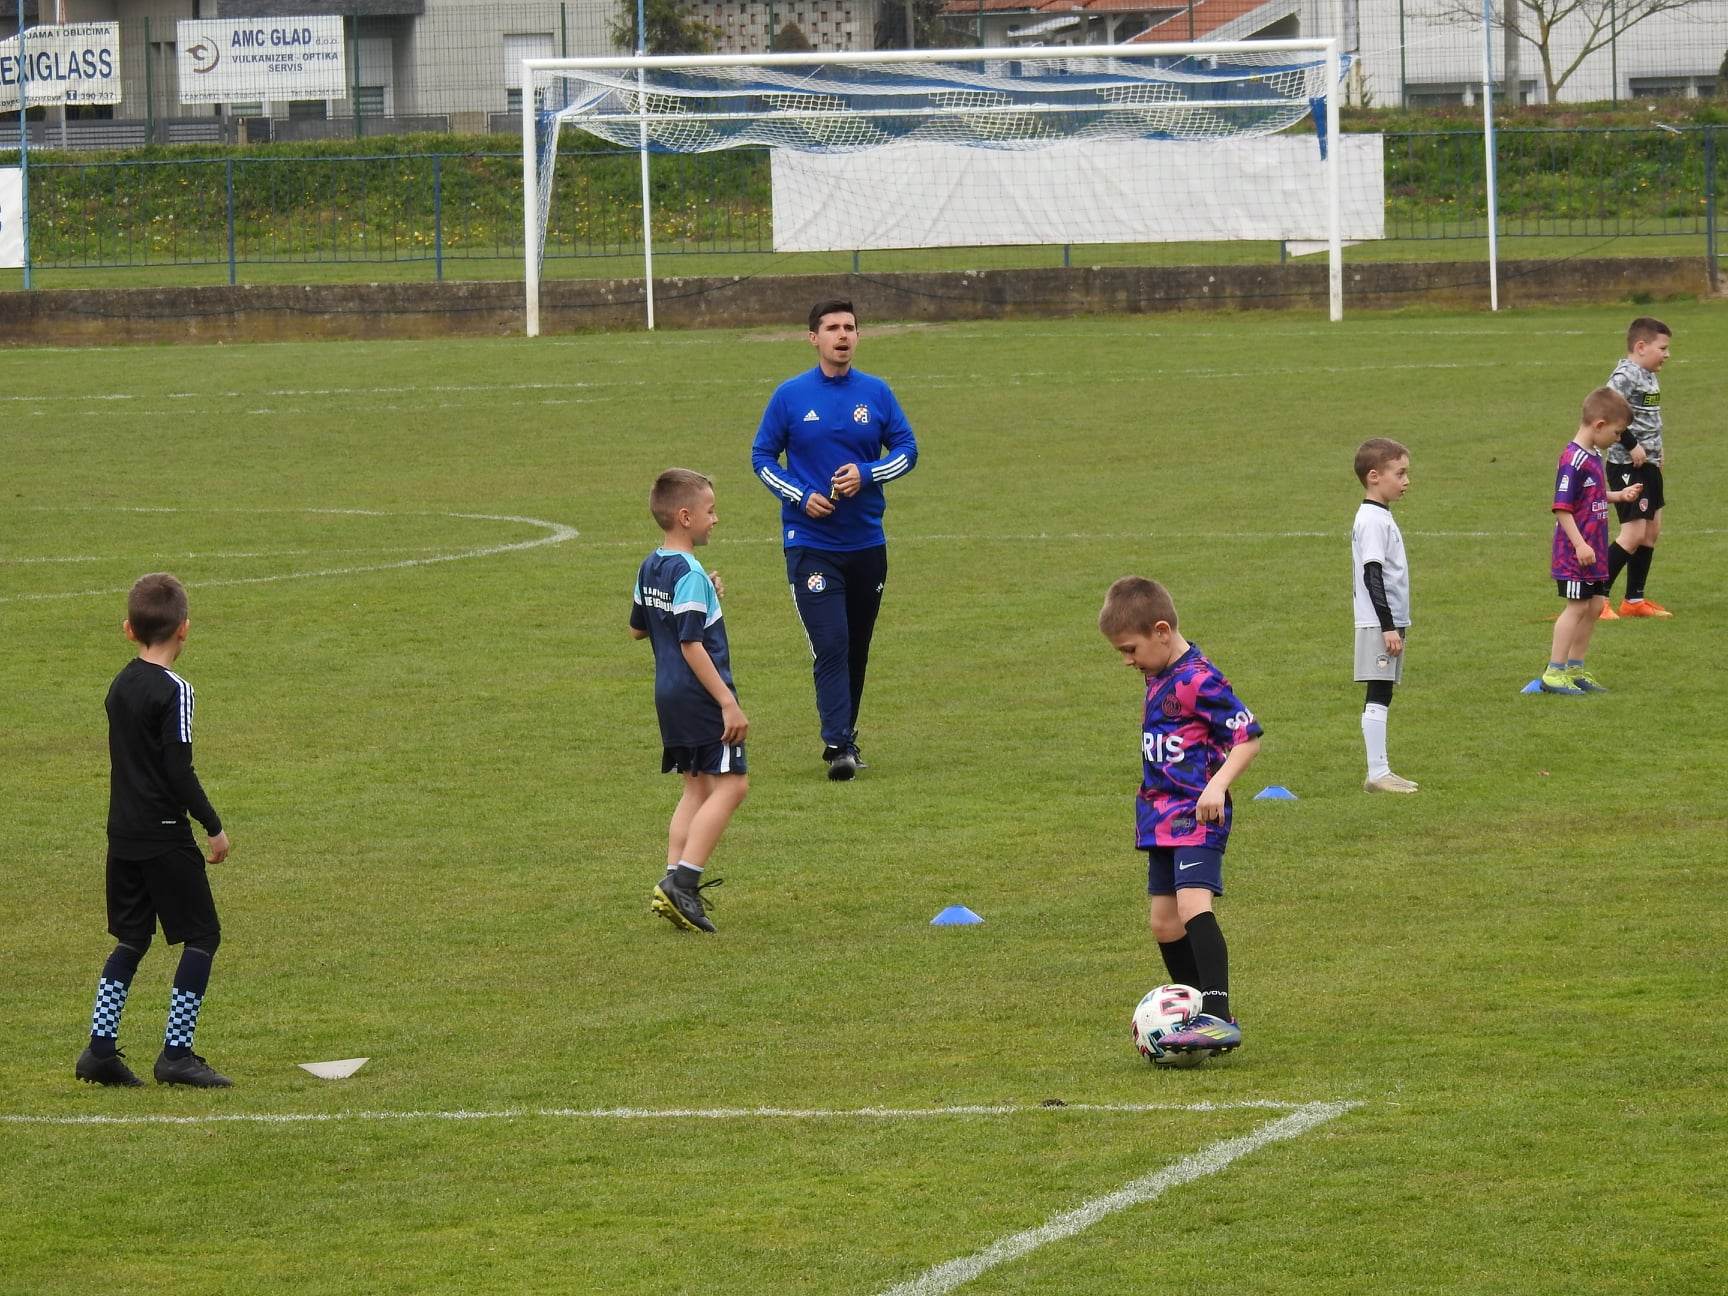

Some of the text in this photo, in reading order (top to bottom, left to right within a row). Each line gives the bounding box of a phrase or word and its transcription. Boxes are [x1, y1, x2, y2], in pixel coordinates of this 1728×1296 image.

[62, 27, 111, 37] OBLICIMA
[231, 29, 265, 47] AMC
[270, 28, 312, 46] GLAD
[232, 53, 294, 63] VULKANIZER
[302, 52, 338, 61] OPTIKA
[0, 48, 112, 85] EXIGLASS
[268, 63, 303, 72] SERVIS
[1141, 732, 1185, 763] RIS
